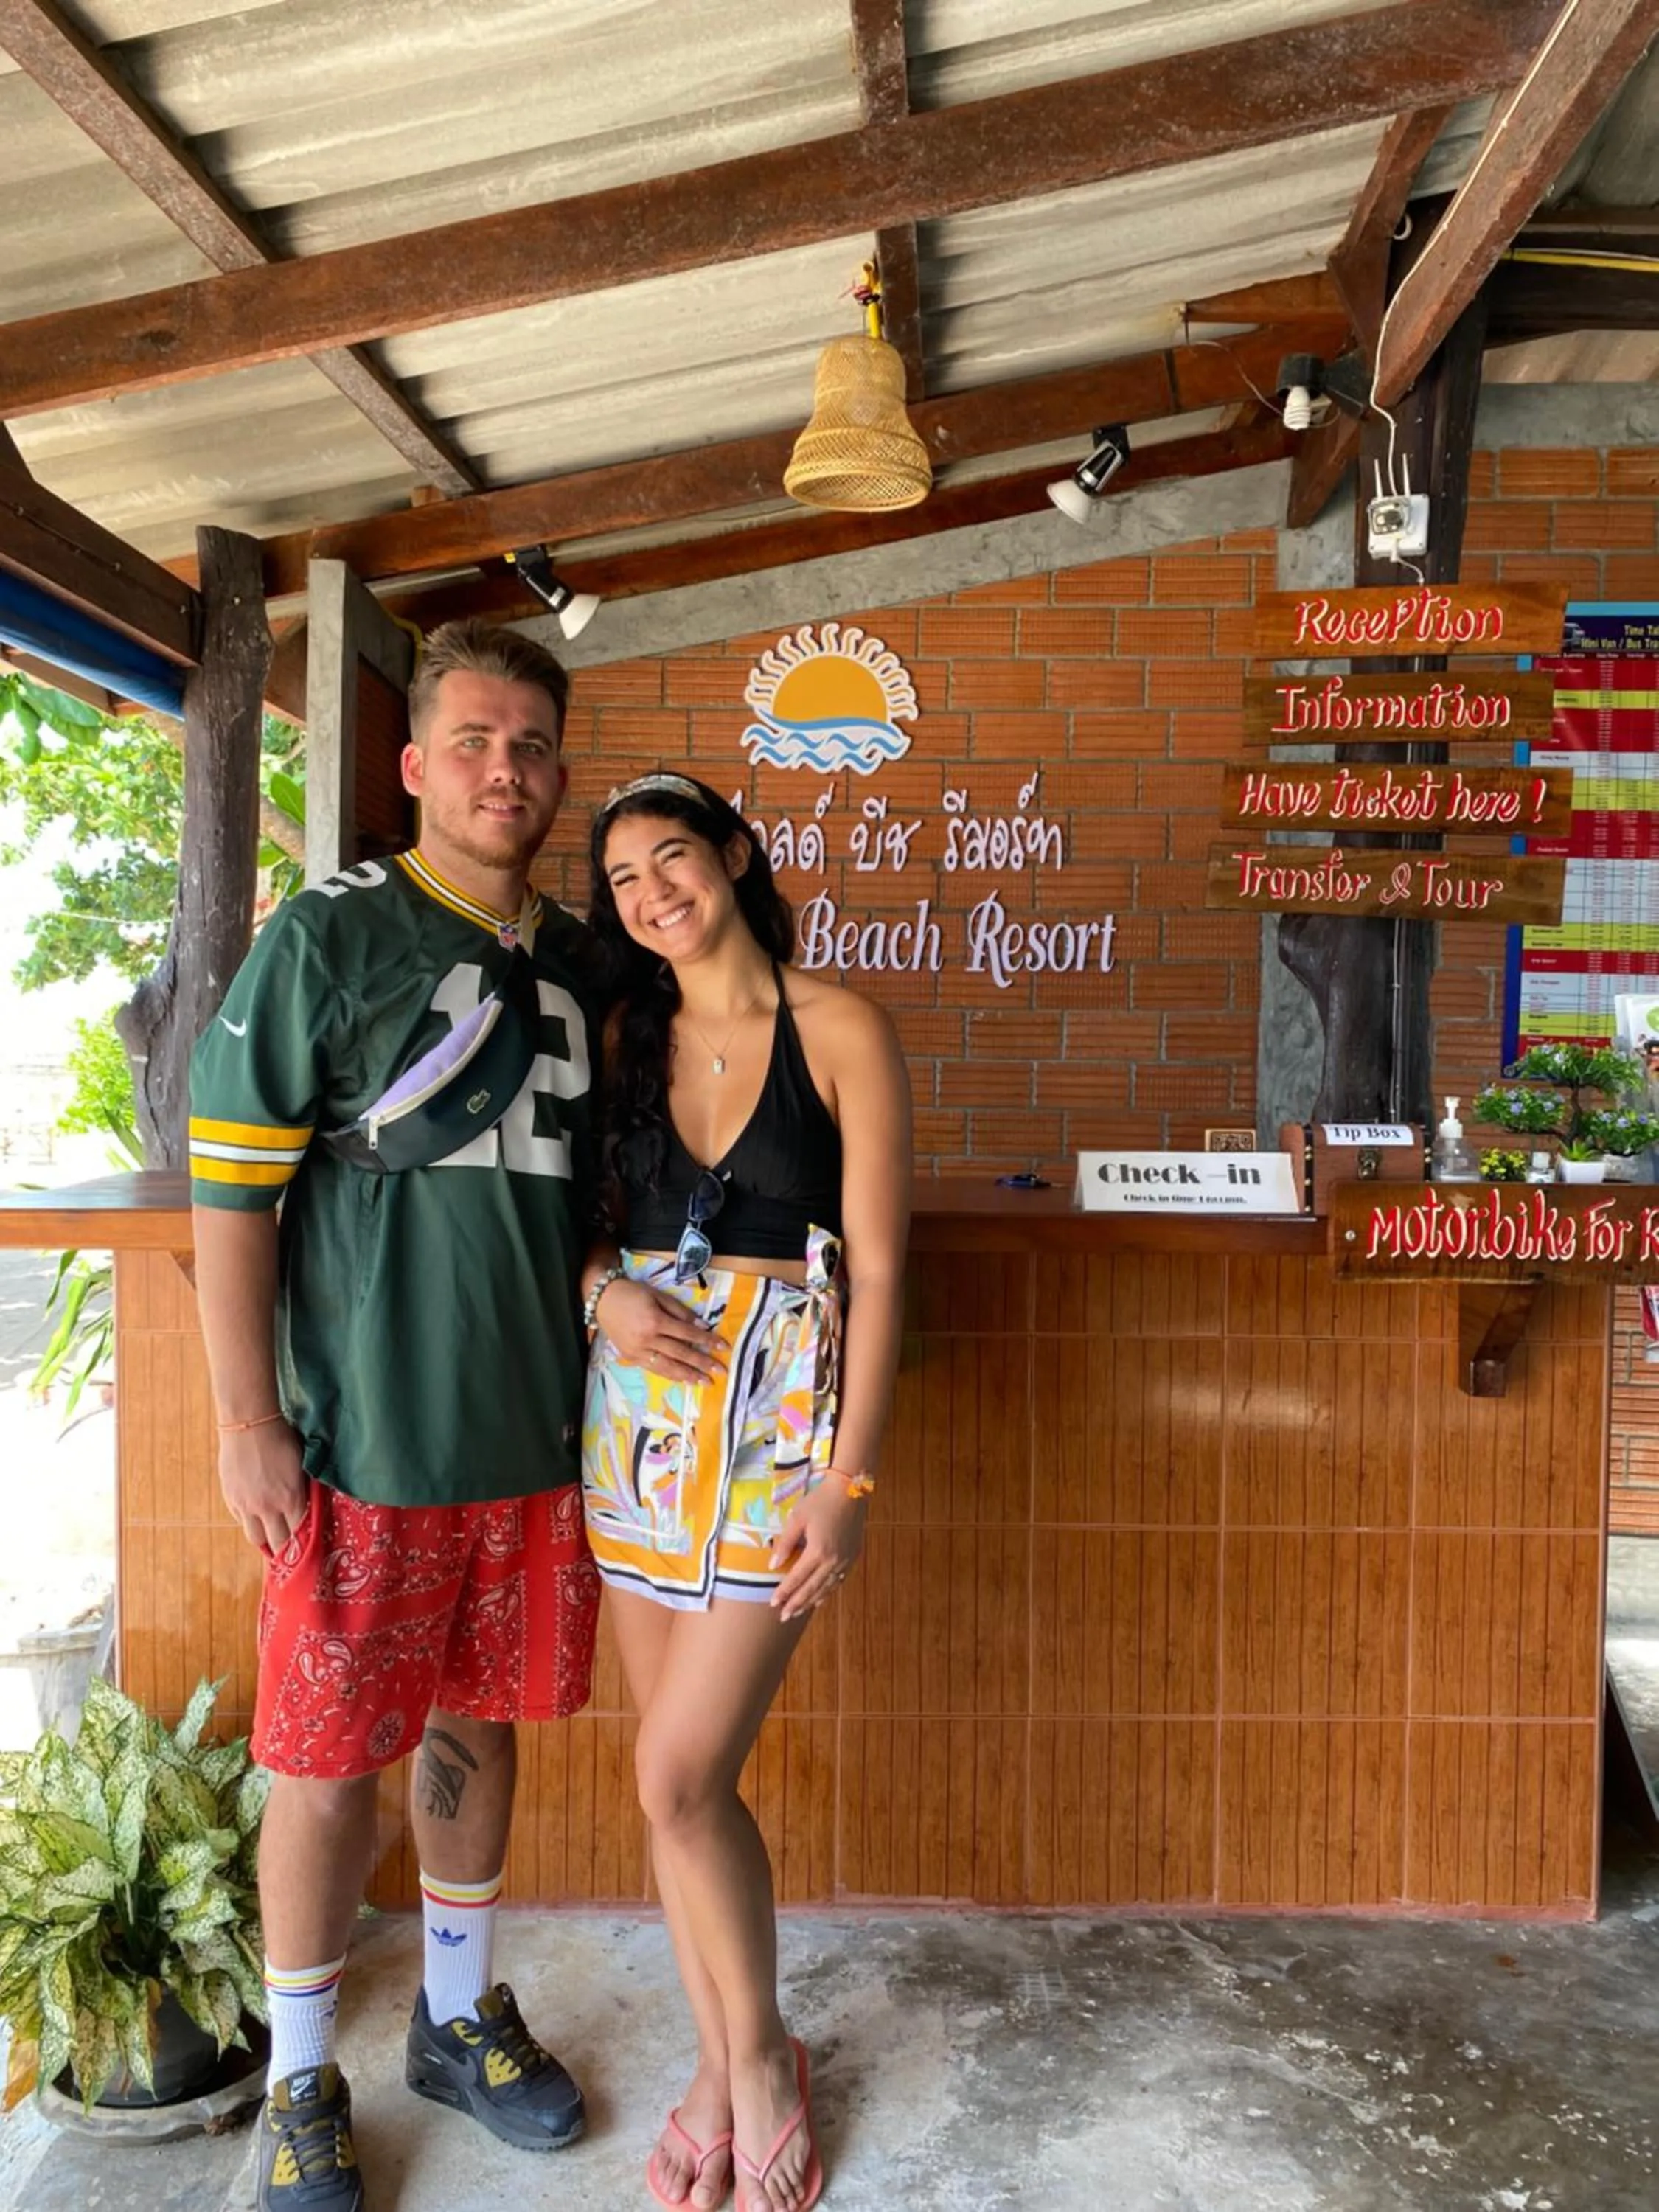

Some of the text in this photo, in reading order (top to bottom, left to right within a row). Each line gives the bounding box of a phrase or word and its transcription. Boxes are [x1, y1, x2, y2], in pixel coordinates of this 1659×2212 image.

[1271, 675, 1511, 733] Information
[942, 771, 1062, 872] รีสอร์ท
[1239, 772, 1322, 817] Have
[1329, 768, 1443, 821] ticket
[1446, 773, 1522, 824] here
[1232, 849, 1504, 911] Transfer & Tour
[799, 888, 1117, 990] Beach Resort
[1367, 1127, 1402, 1138] Box
[1098, 1163, 1201, 1184] Check
